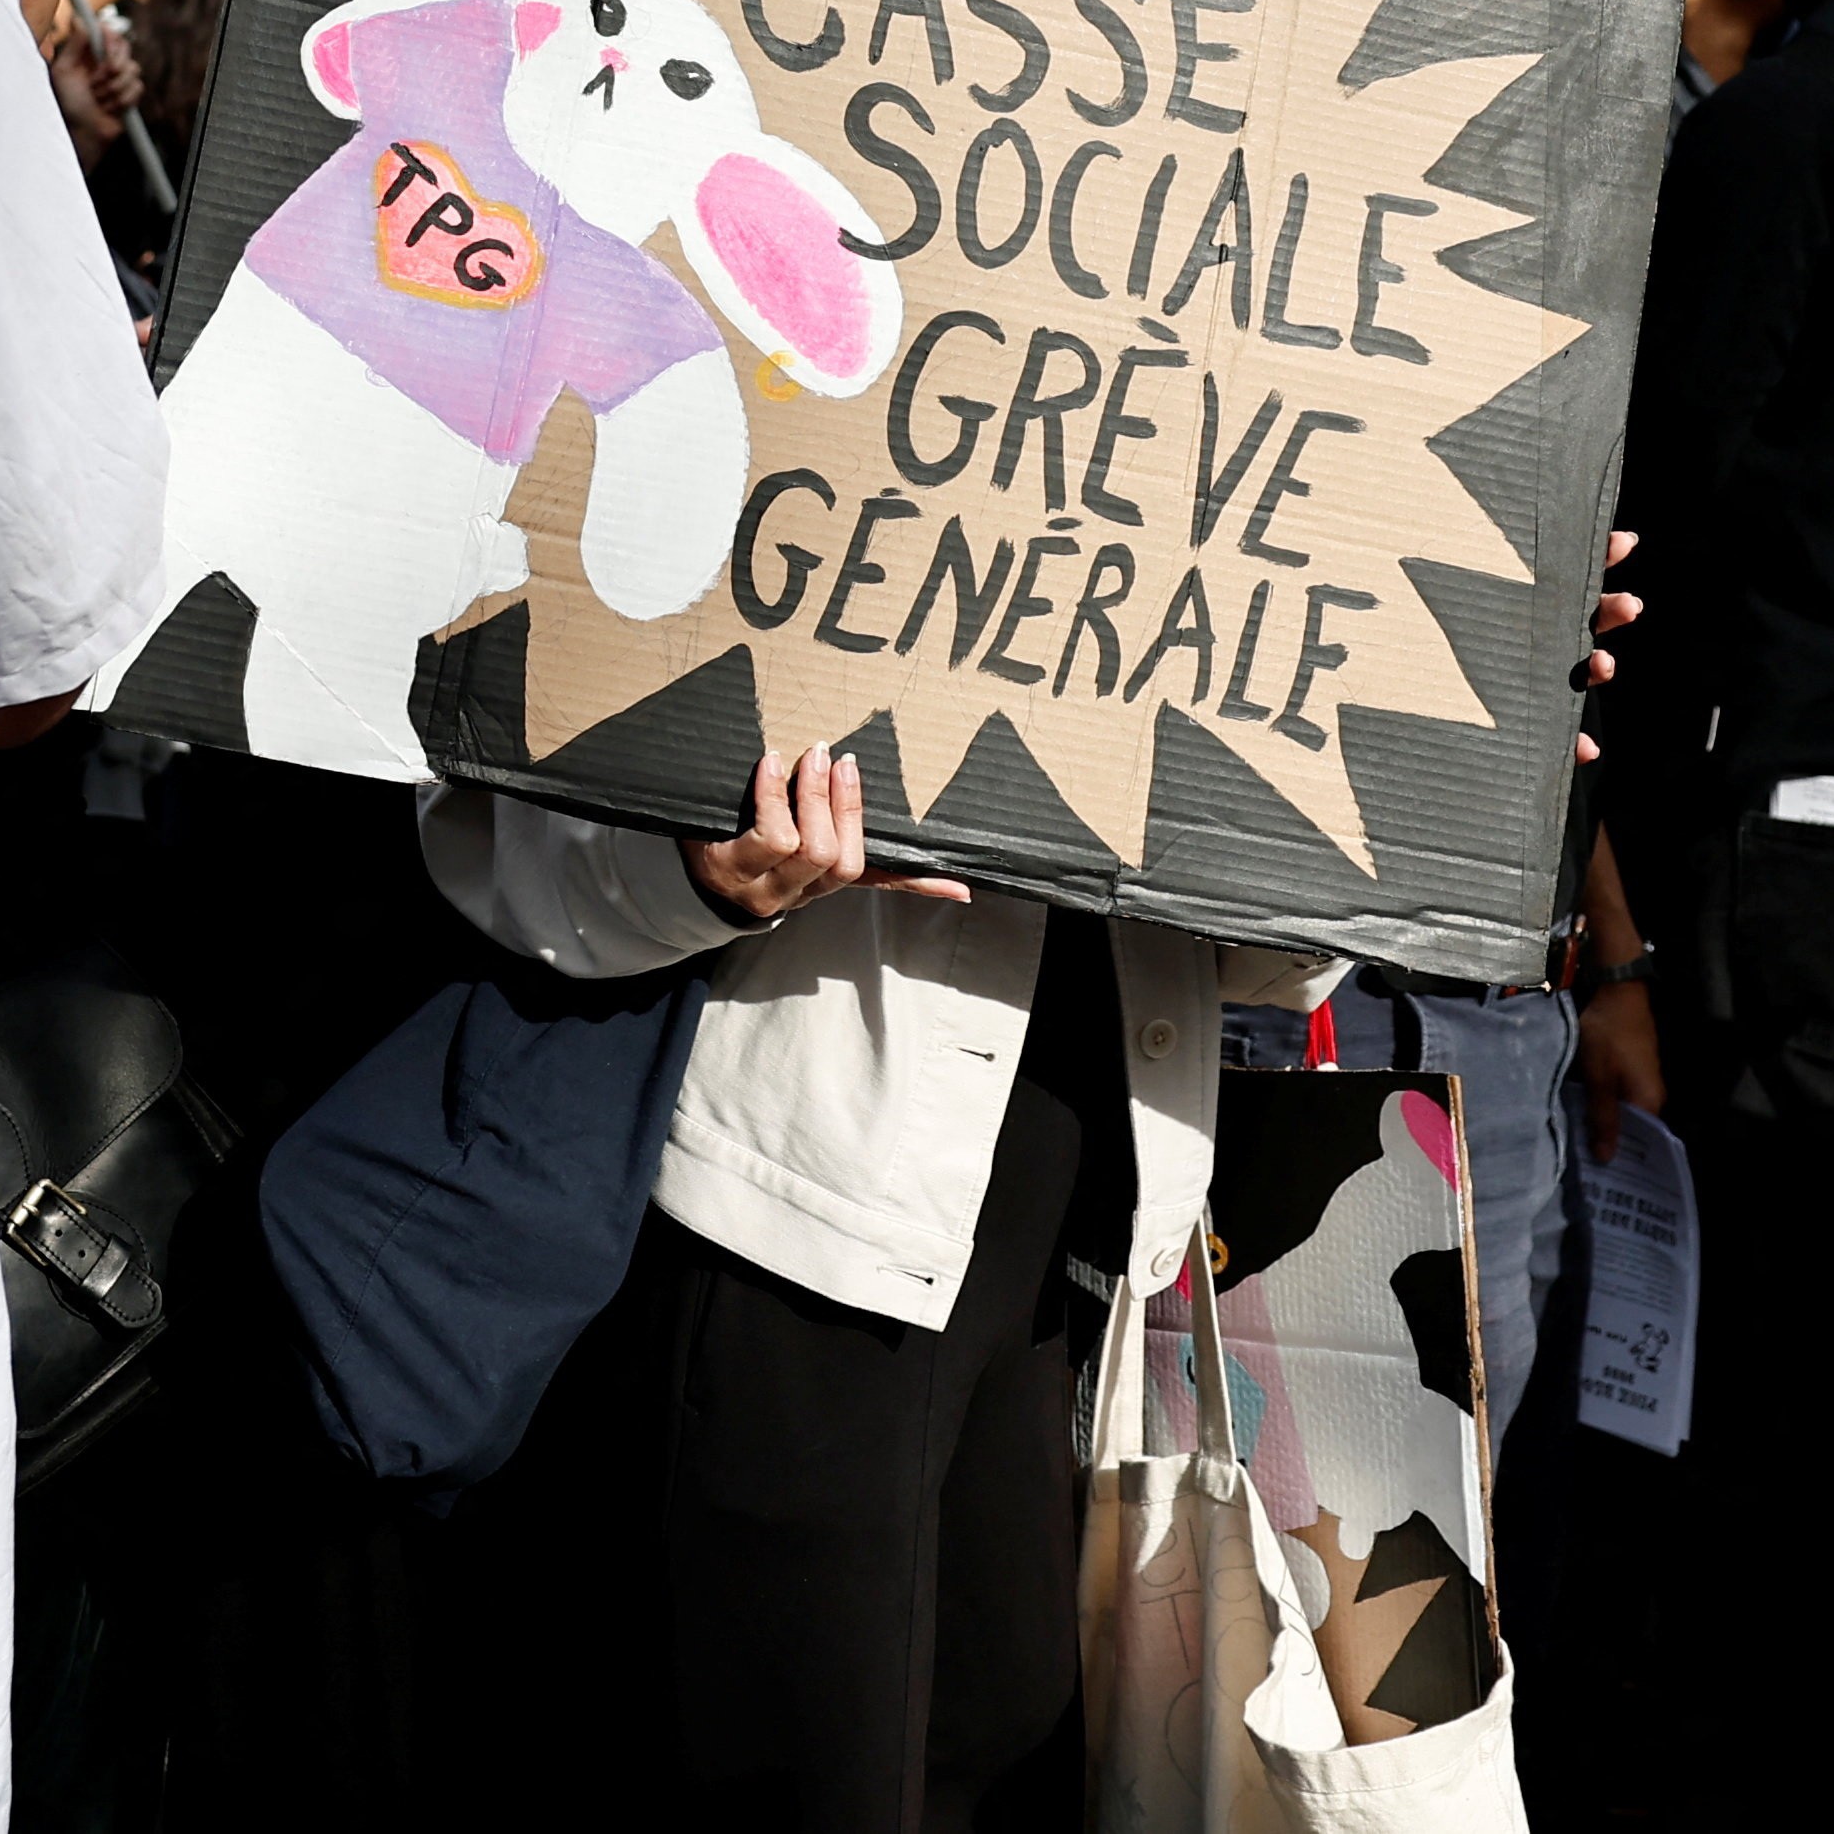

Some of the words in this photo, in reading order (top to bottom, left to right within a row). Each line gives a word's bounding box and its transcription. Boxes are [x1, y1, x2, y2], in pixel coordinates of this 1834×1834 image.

[377, 142, 515, 291] TPG
[838, 81, 1440, 365] SOCIALE
[887, 309, 1366, 569] GRÈVE
[730, 468, 1381, 752] GÉNÉRALE
